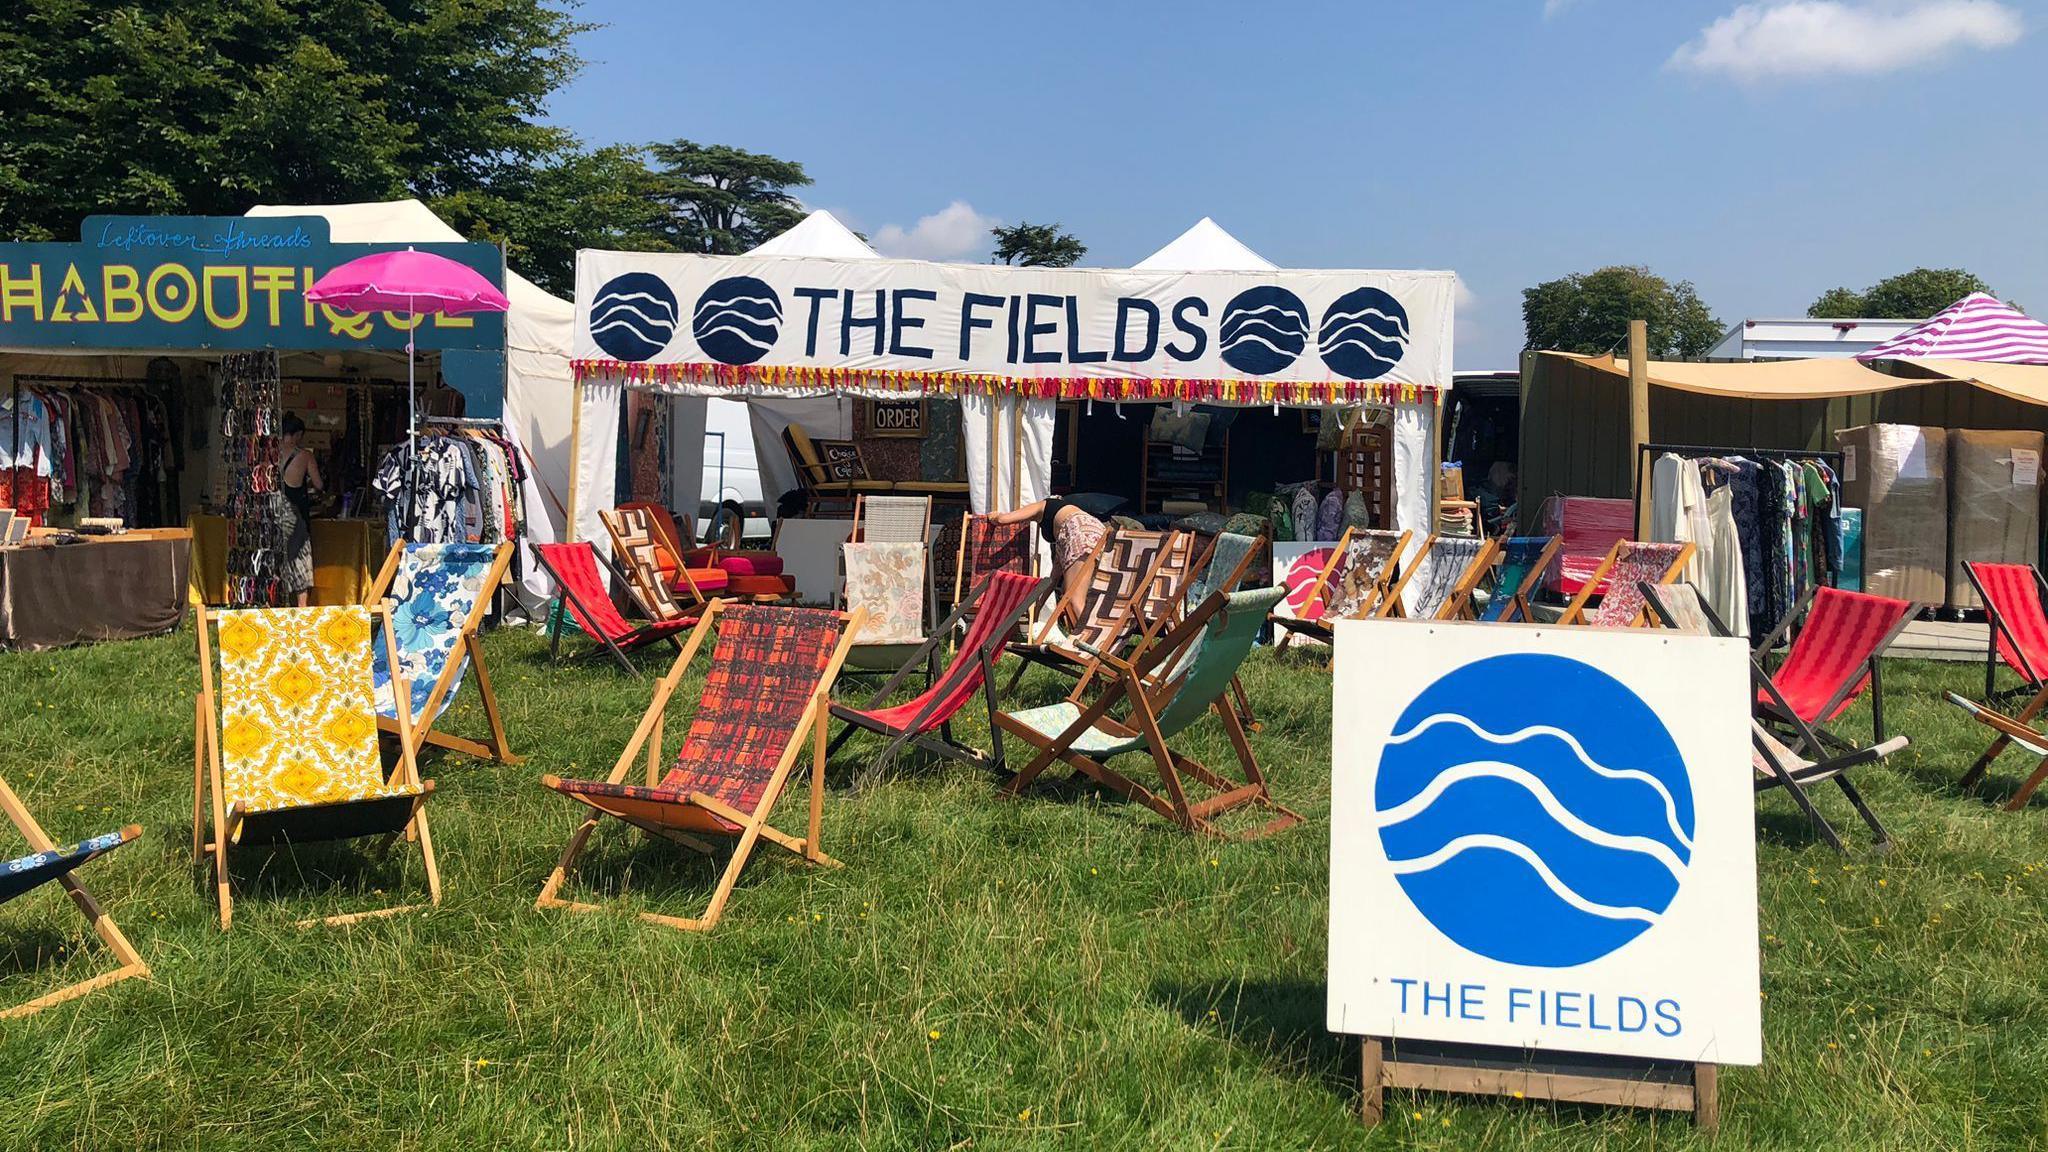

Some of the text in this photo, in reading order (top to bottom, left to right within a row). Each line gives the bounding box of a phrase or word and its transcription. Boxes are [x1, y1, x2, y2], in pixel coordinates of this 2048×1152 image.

[97, 220, 197, 251] Leftover
[793, 287, 1209, 364] THE FIELDS
[876, 407, 919, 428] ORDER
[1390, 978, 1682, 1038] THE FIELDS
